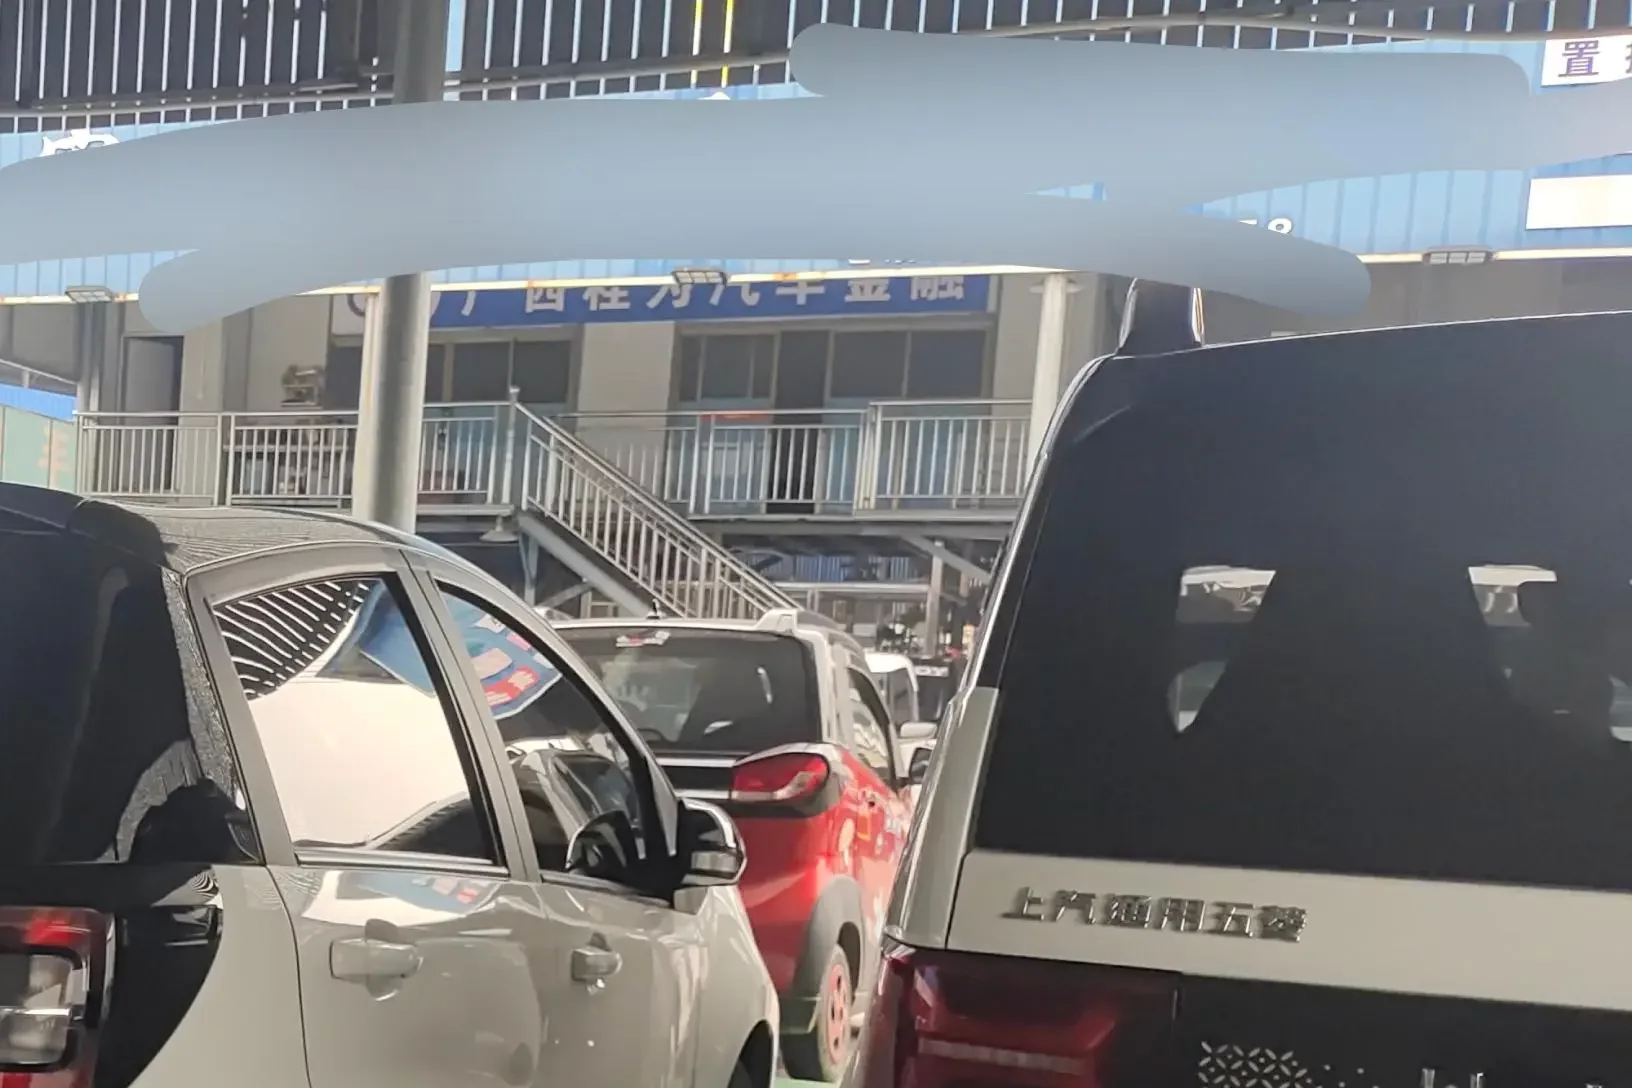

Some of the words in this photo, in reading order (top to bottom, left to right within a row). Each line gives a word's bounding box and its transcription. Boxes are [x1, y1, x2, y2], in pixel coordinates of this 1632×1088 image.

[1000, 887, 1306, 942] 上汽通用五菱
